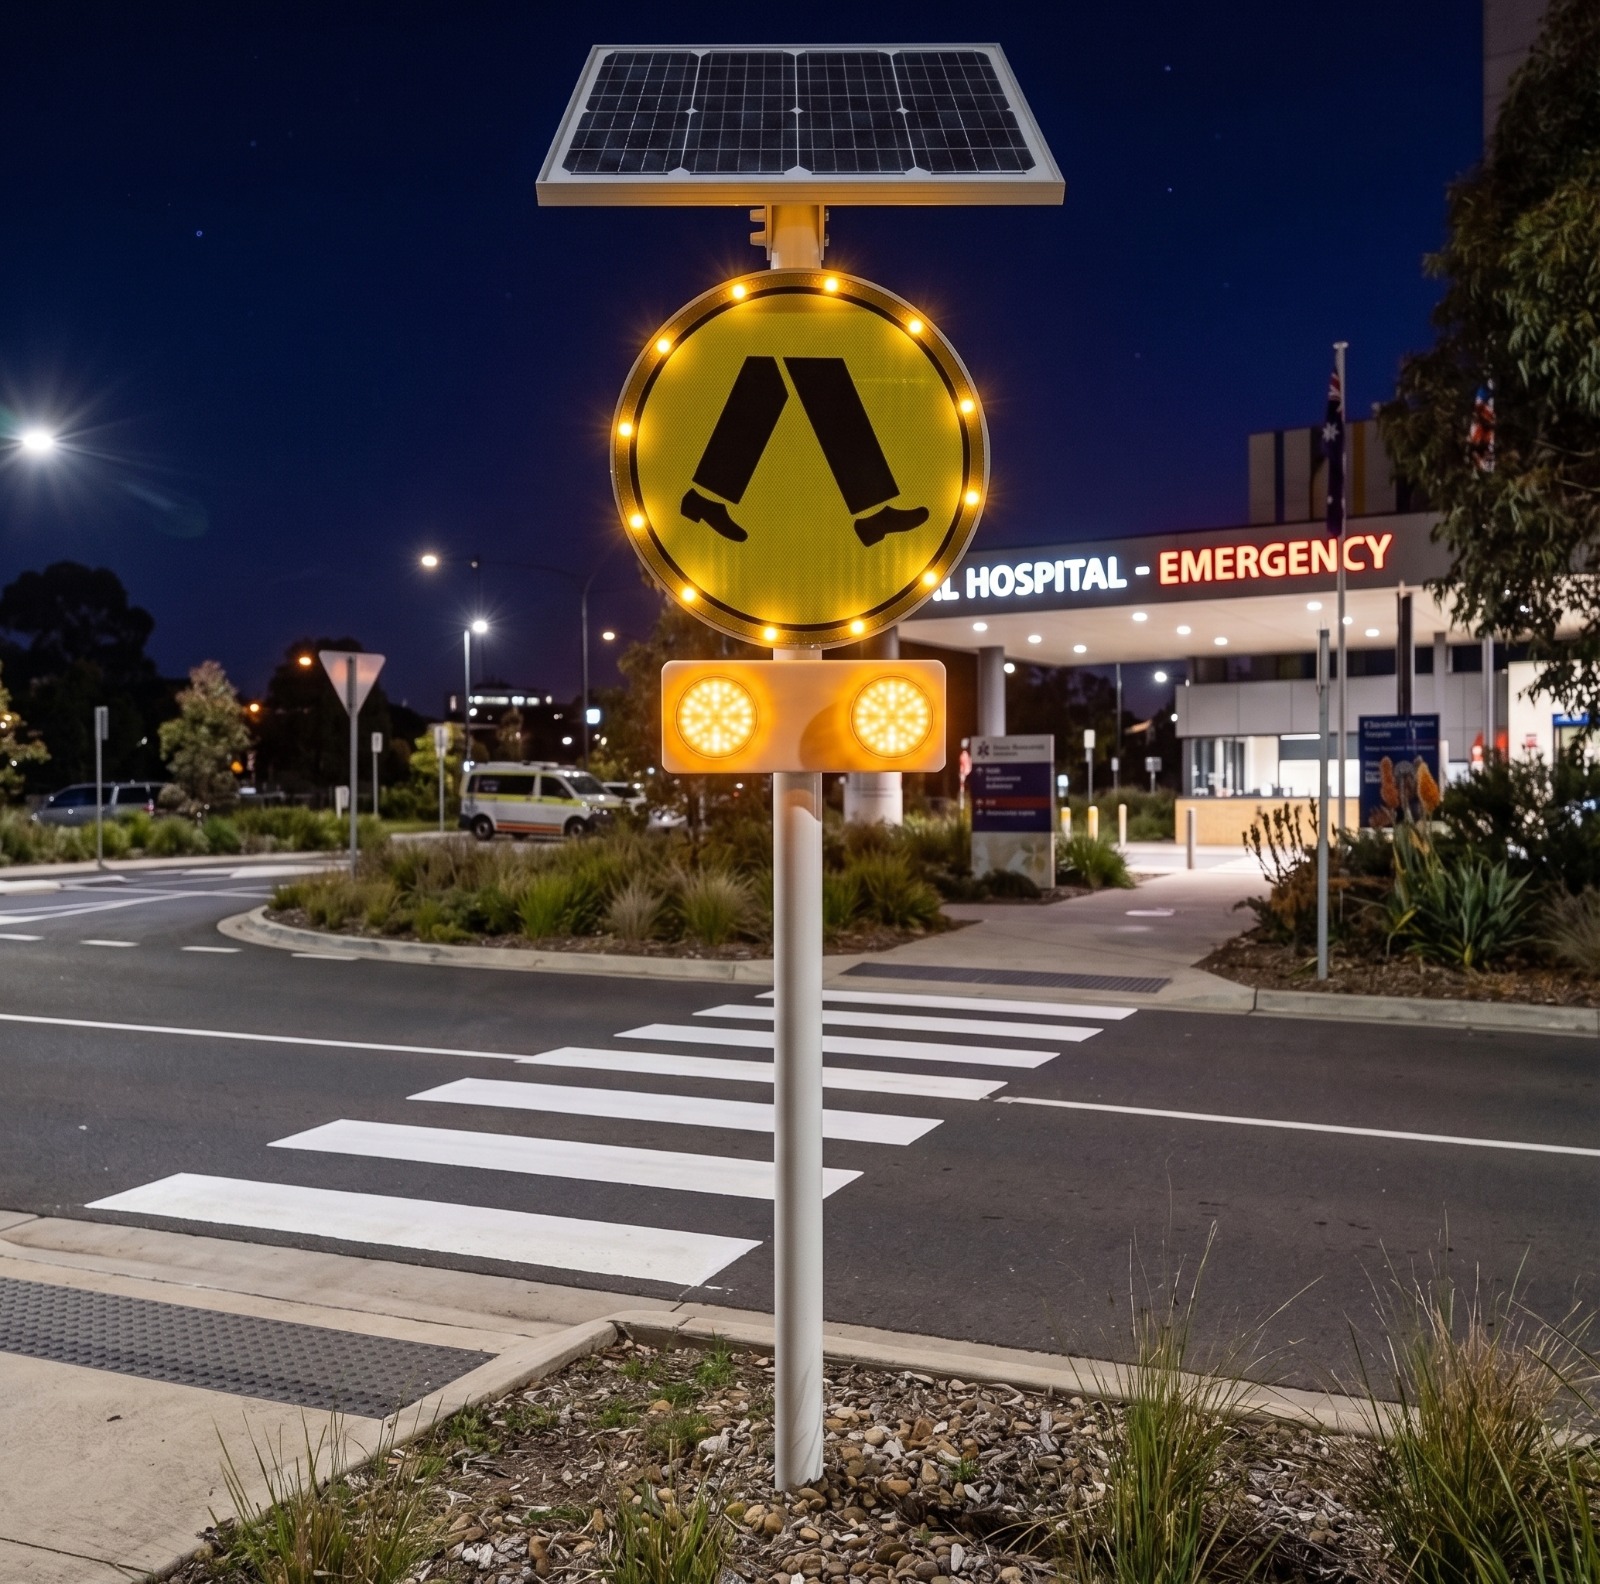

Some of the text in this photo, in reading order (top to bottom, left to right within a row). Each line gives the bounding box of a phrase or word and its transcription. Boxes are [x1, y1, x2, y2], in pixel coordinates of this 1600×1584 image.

[932, 533, 1393, 602] L HOSPITAL - EMERGENCY
